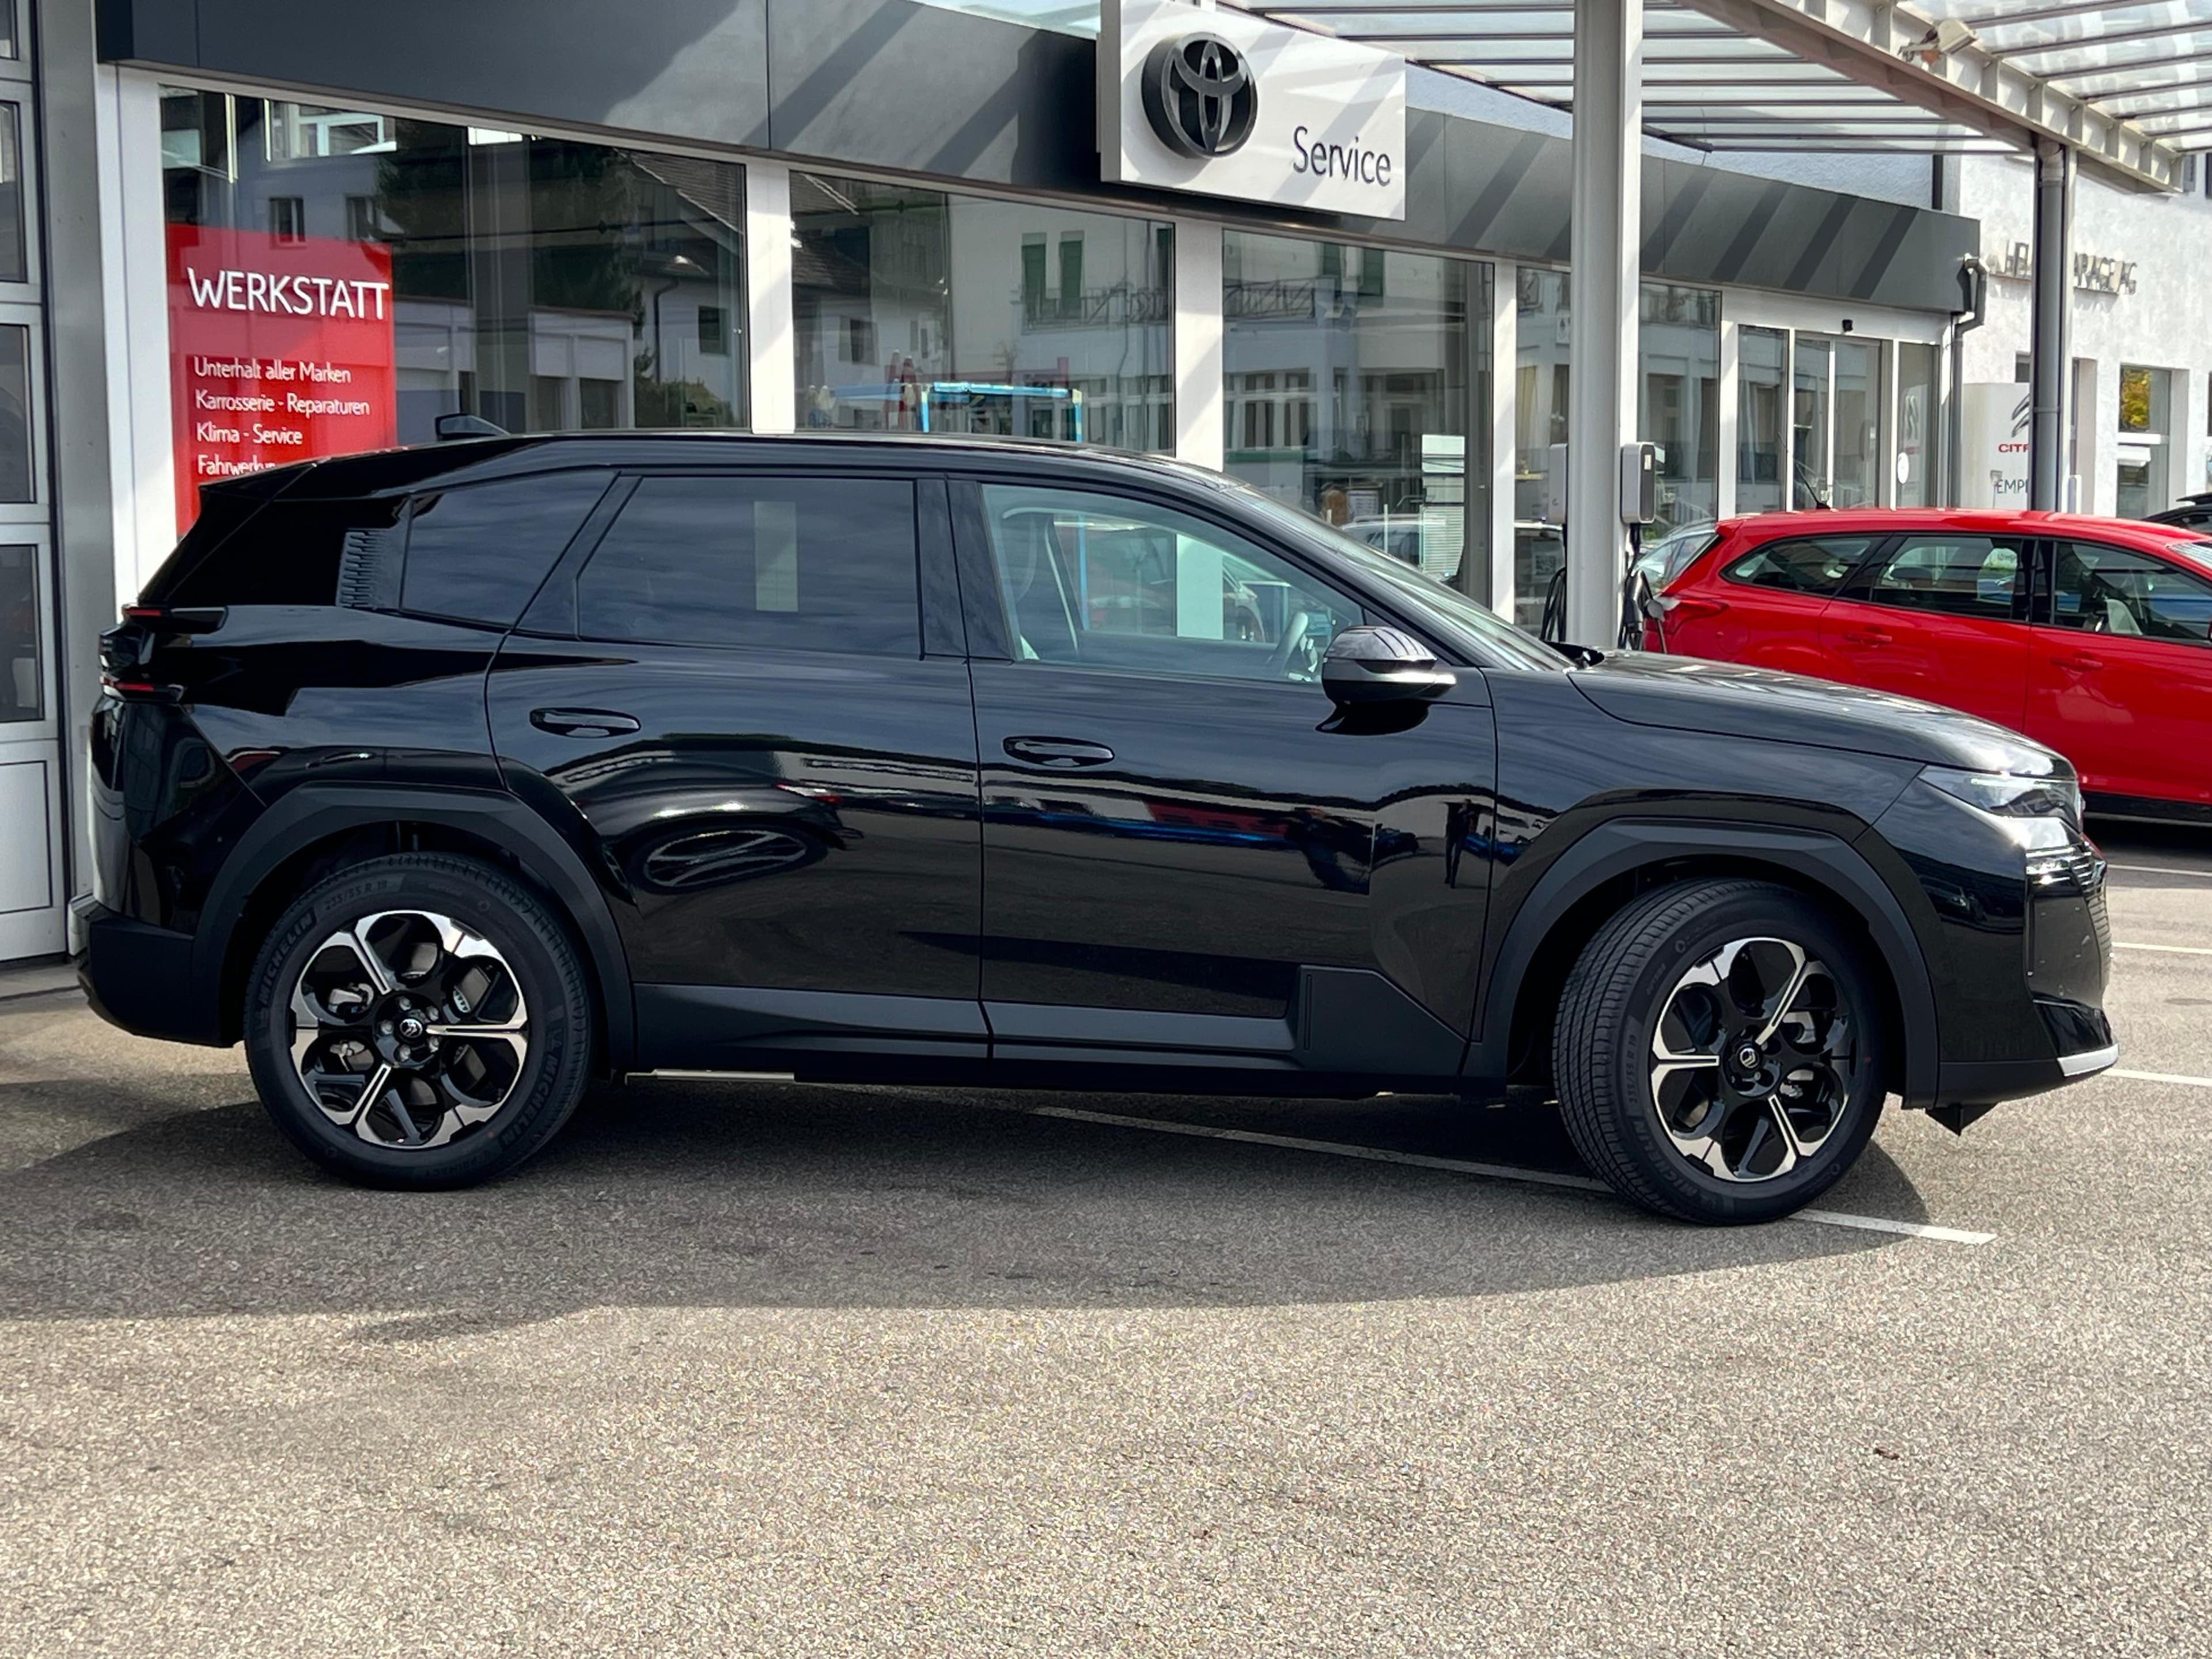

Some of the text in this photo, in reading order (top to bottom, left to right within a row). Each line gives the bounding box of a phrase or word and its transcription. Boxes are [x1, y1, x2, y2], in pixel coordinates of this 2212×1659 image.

[1293, 126, 1391, 187] Service
[187, 267, 389, 320] WERKSTATT
[194, 356, 352, 384] Unterhalt aller Marken
[195, 389, 275, 412] Karrosserie
[287, 392, 370, 419] Reparaturen
[196, 422, 240, 442] Klima
[252, 423, 302, 445] Service
[1997, 479, 2028, 494] EMP
[258, 911, 315, 1005] MICHELIN
[501, 1054, 558, 1146] MICHELIN
[1633, 1120, 1698, 1196] MICHELIN
